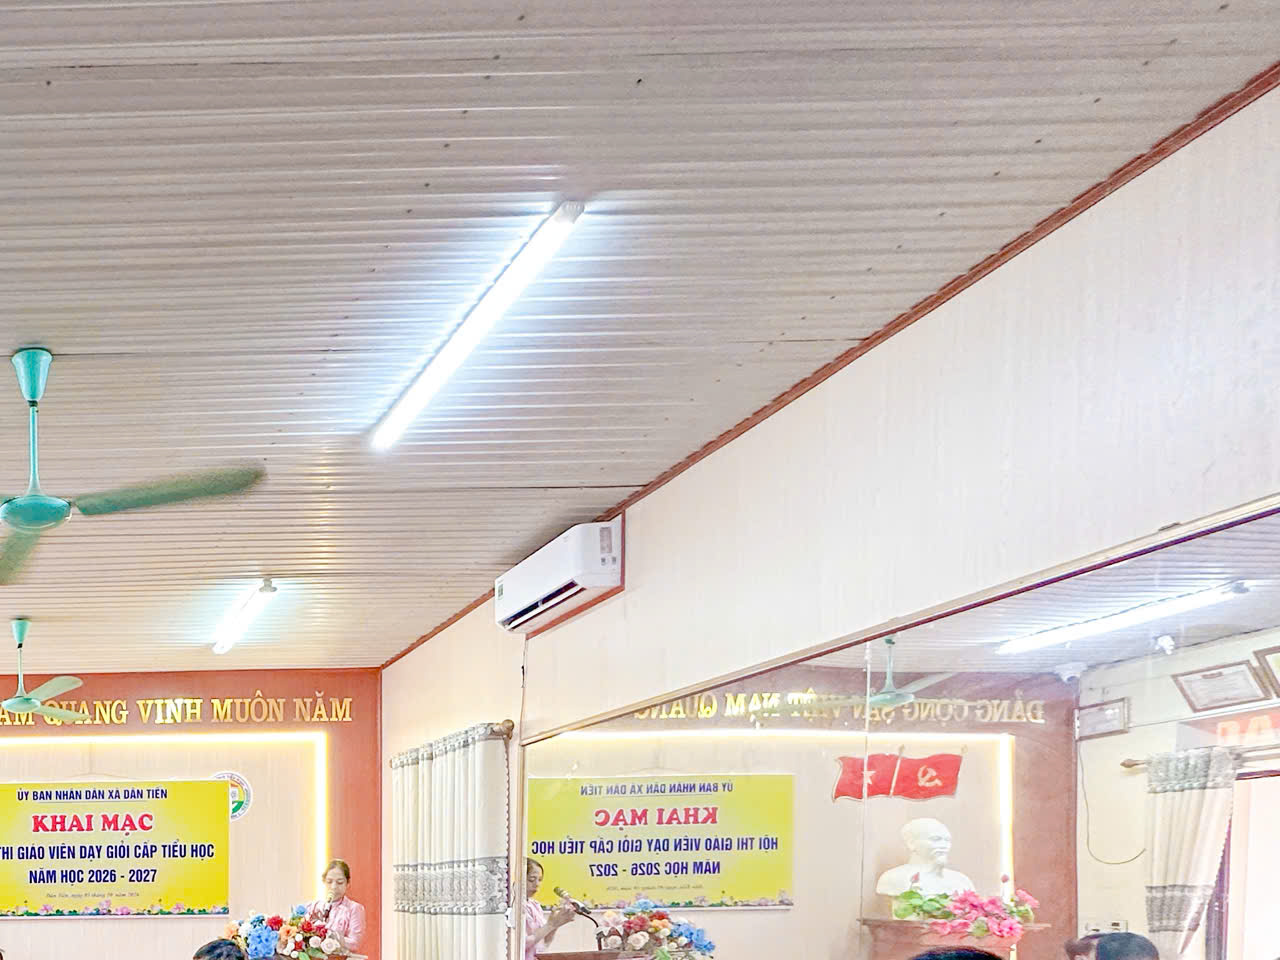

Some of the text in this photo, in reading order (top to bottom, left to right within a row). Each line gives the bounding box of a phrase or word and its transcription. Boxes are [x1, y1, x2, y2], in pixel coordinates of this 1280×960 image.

[136, 698, 203, 724] VINH
[211, 690, 285, 723] MUÔN
[294, 691, 353, 723] NĂM
[17, 786, 168, 801] ỦY BAN NHÂN DÂN XÃ DÂN TIẾN
[32, 814, 153, 836] KHAI MẠC
[17, 843, 45, 860] GIÁO
[49, 843, 75, 860] VIÊN
[80, 845, 102, 862] DẠY
[106, 840, 130, 859] GIỎI
[134, 840, 157, 858] CẤP
[161, 839, 187, 858] TIỂU
[191, 844, 215, 861] HỌC
[29, 867, 57, 884] NĂM
[60, 870, 84, 886] HỌC
[88, 869, 117, 883] 2026
[128, 869, 157, 883] 2027
